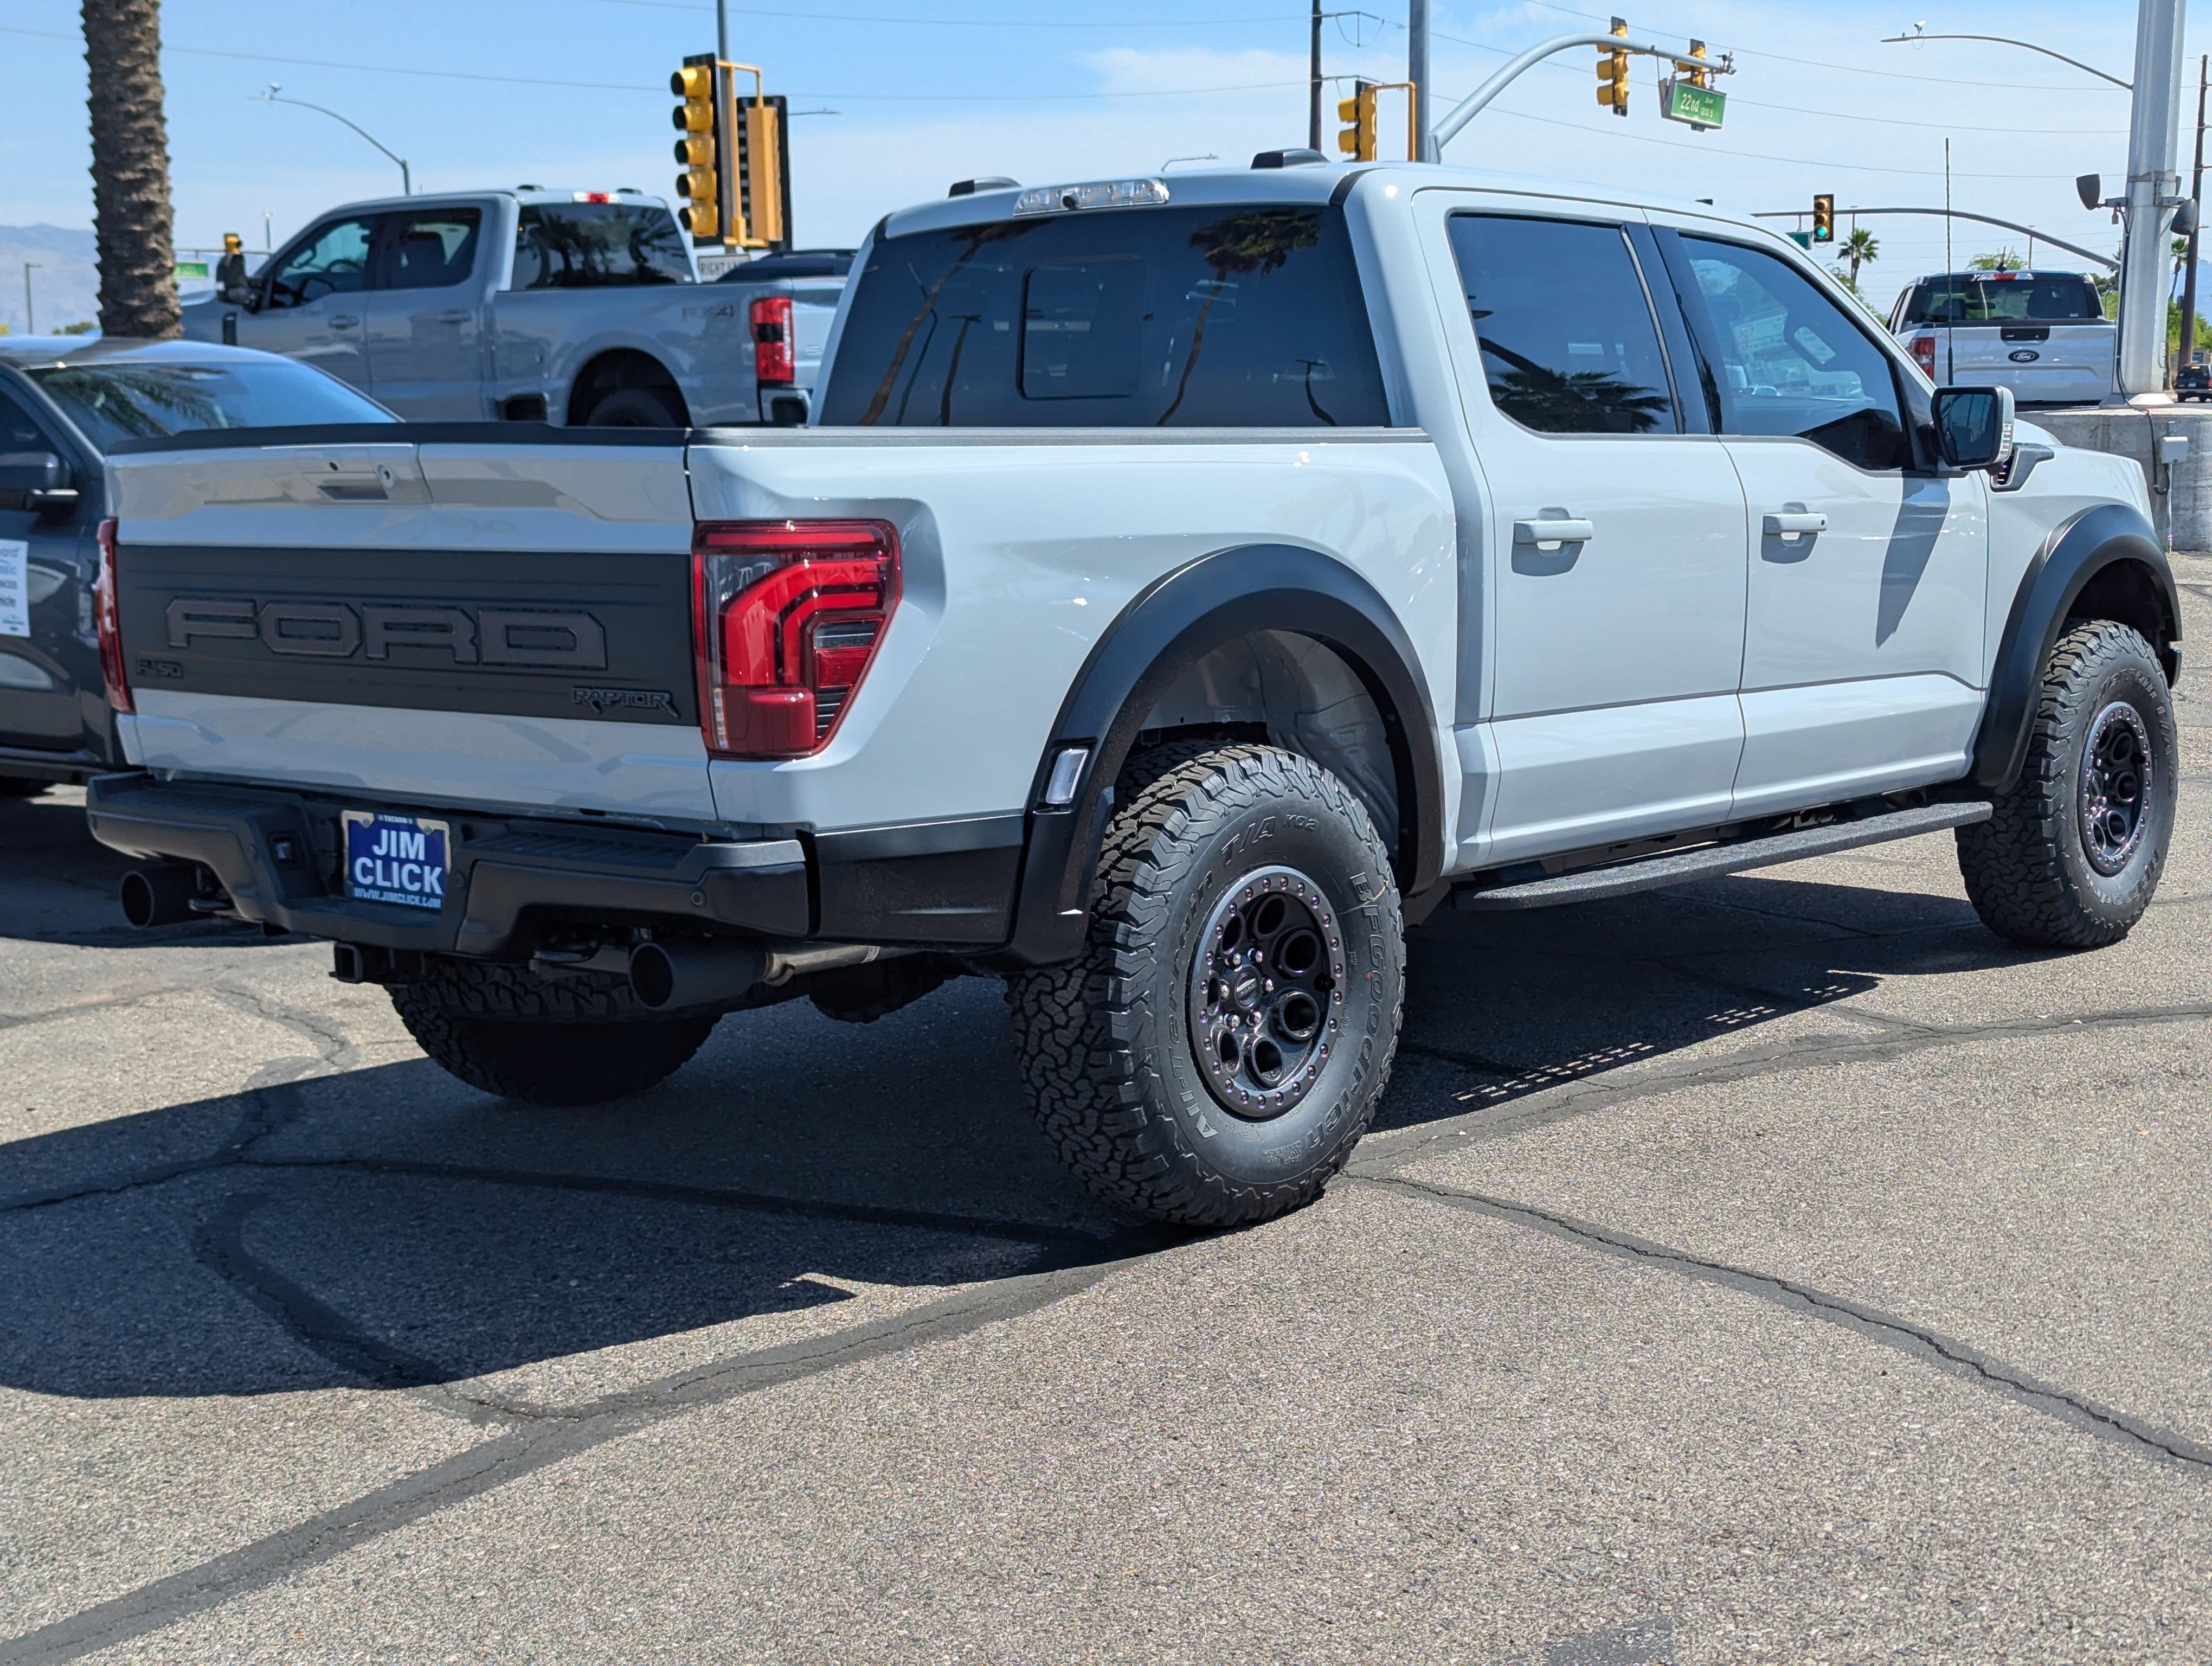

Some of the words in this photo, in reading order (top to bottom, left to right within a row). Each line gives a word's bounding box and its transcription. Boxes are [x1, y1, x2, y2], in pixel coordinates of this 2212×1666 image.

[1680, 93, 1701, 113] 22nd
[682, 305, 734, 322] FX4
[166, 597, 608, 670] FORD
[572, 685, 680, 719] RAPTOR
[384, 815, 408, 824] TUCSON
[372, 829, 425, 861] JIM
[1221, 816, 1276, 866] T/A
[355, 856, 443, 895] CLICK
[354, 887, 441, 909] WWW.JIMCLICK.COM
[1306, 872, 1387, 1150] BFGoodrich
